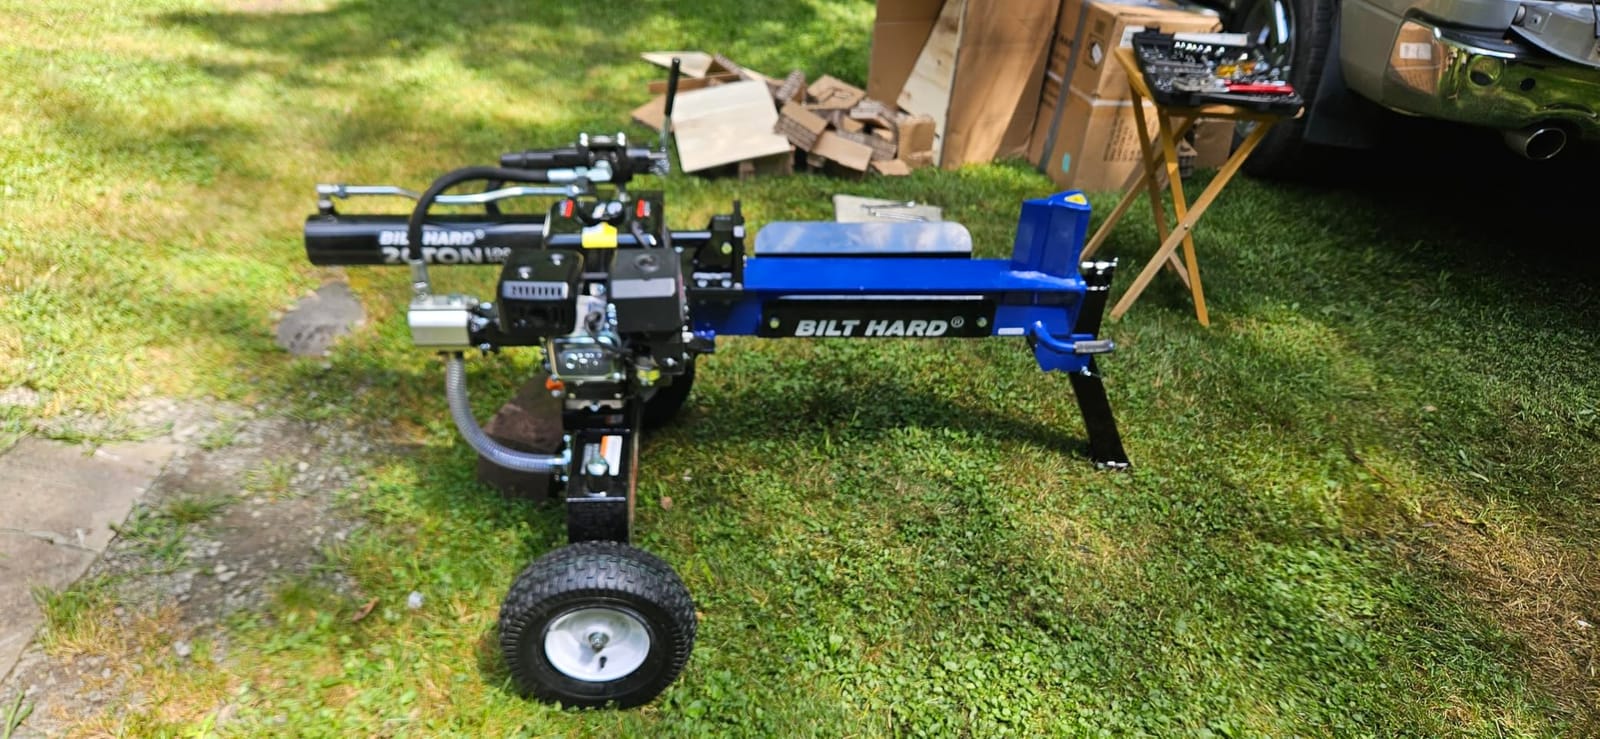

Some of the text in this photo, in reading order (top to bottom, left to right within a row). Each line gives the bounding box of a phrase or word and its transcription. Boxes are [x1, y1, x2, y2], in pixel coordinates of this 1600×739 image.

[379, 231, 409, 245] BIL
[421, 247, 483, 264] TON
[795, 320, 861, 337] BILT
